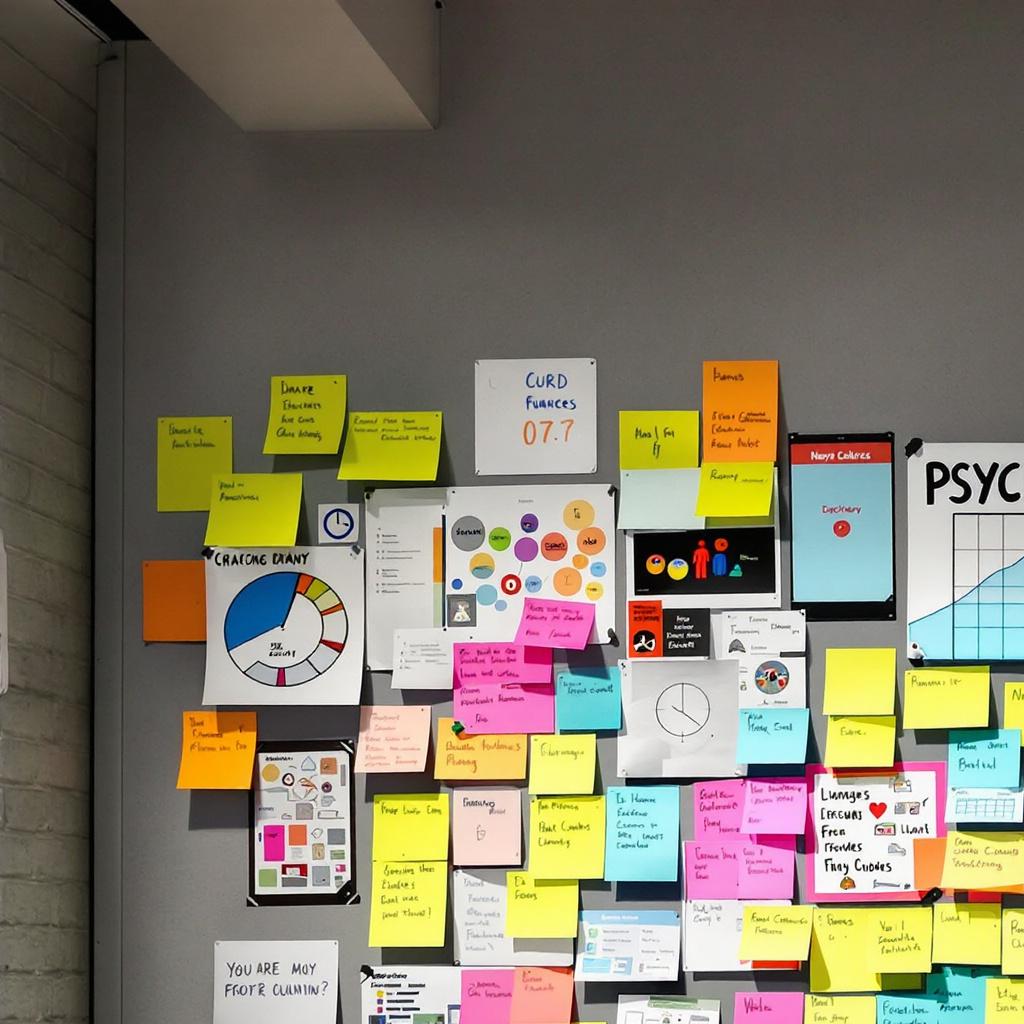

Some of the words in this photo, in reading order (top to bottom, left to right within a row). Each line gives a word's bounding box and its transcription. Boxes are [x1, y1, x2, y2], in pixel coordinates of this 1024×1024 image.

[526, 372, 568, 389] CURD
[522, 420, 575, 445] 07.7
[226, 962, 252, 978] YOU
[257, 962, 280, 975] ARE
